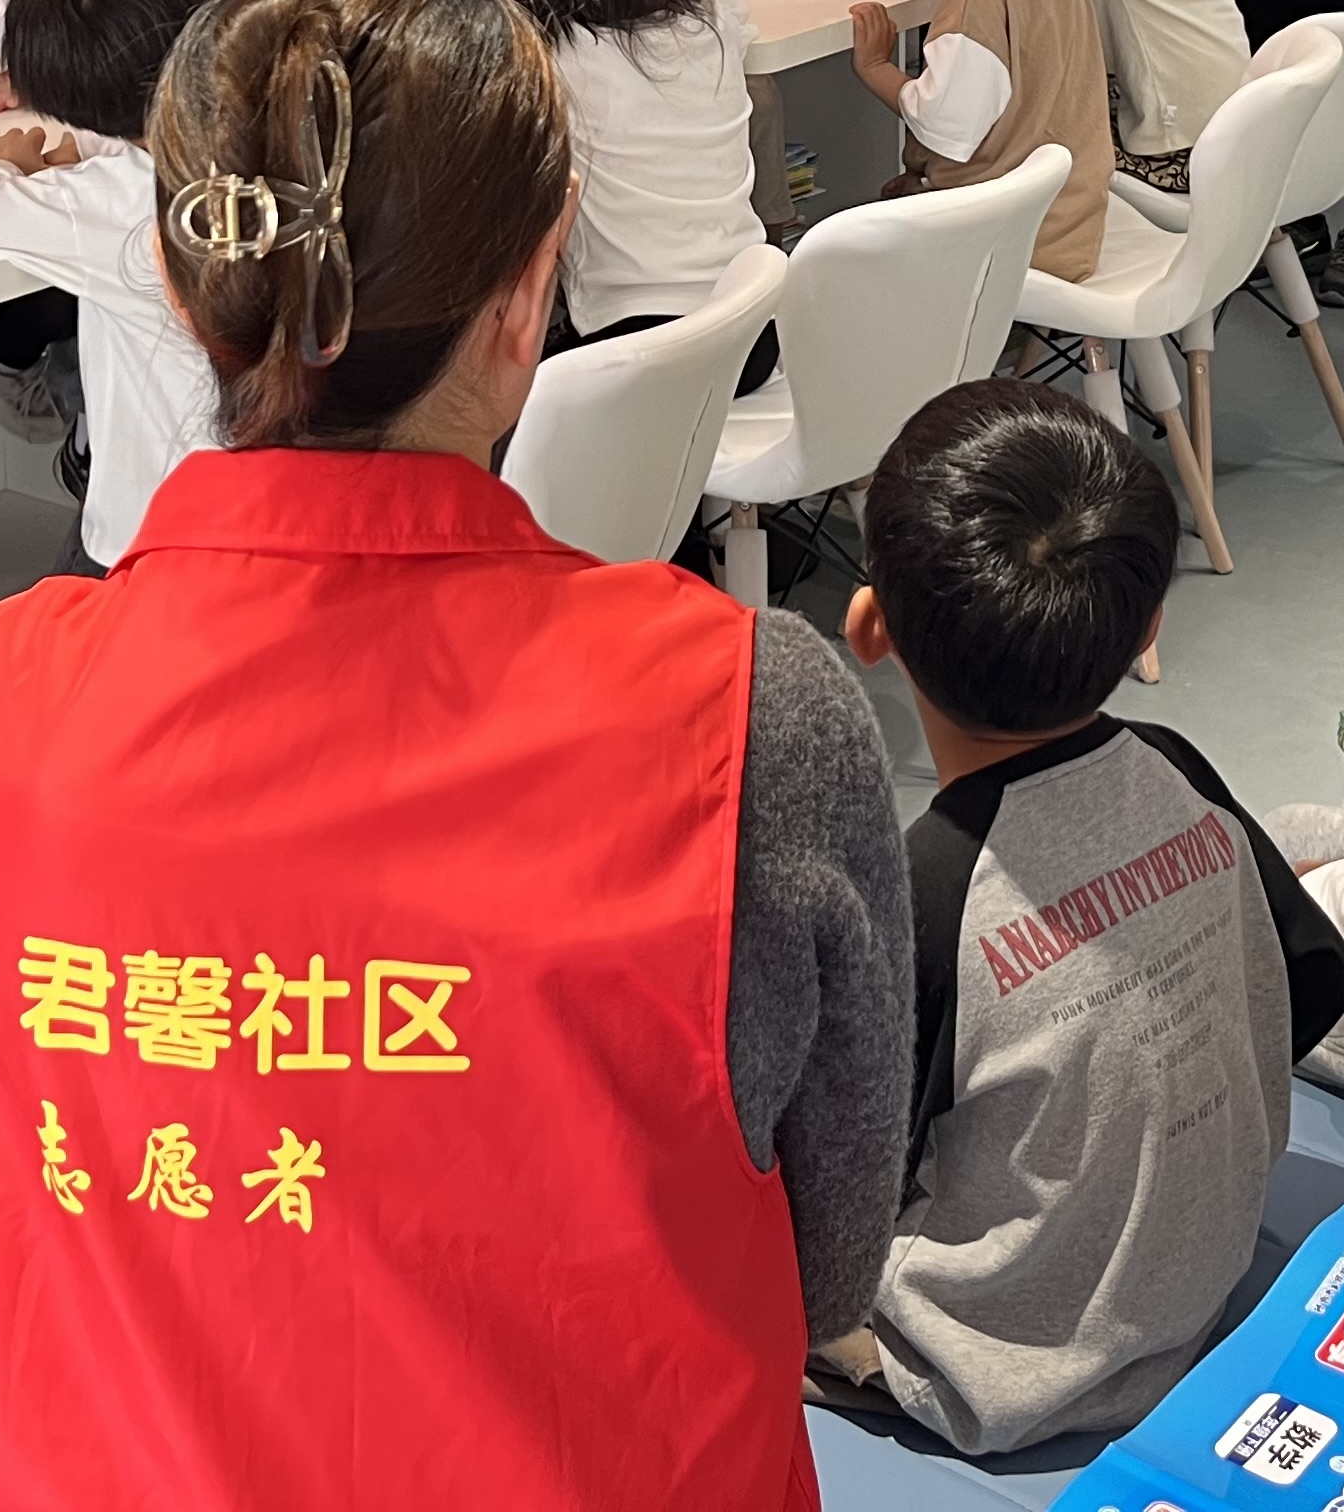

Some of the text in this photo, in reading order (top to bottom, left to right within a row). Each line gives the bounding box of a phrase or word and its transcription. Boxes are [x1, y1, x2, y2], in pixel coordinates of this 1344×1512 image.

[17, 935, 472, 1076] 君馨社区
[1051, 1001, 1086, 1025] PUNK
[1086, 969, 1145, 1011] MOVEMENT
[35, 1099, 326, 1234] 志愿者
[1266, 1419, 1323, 1472] 数学
